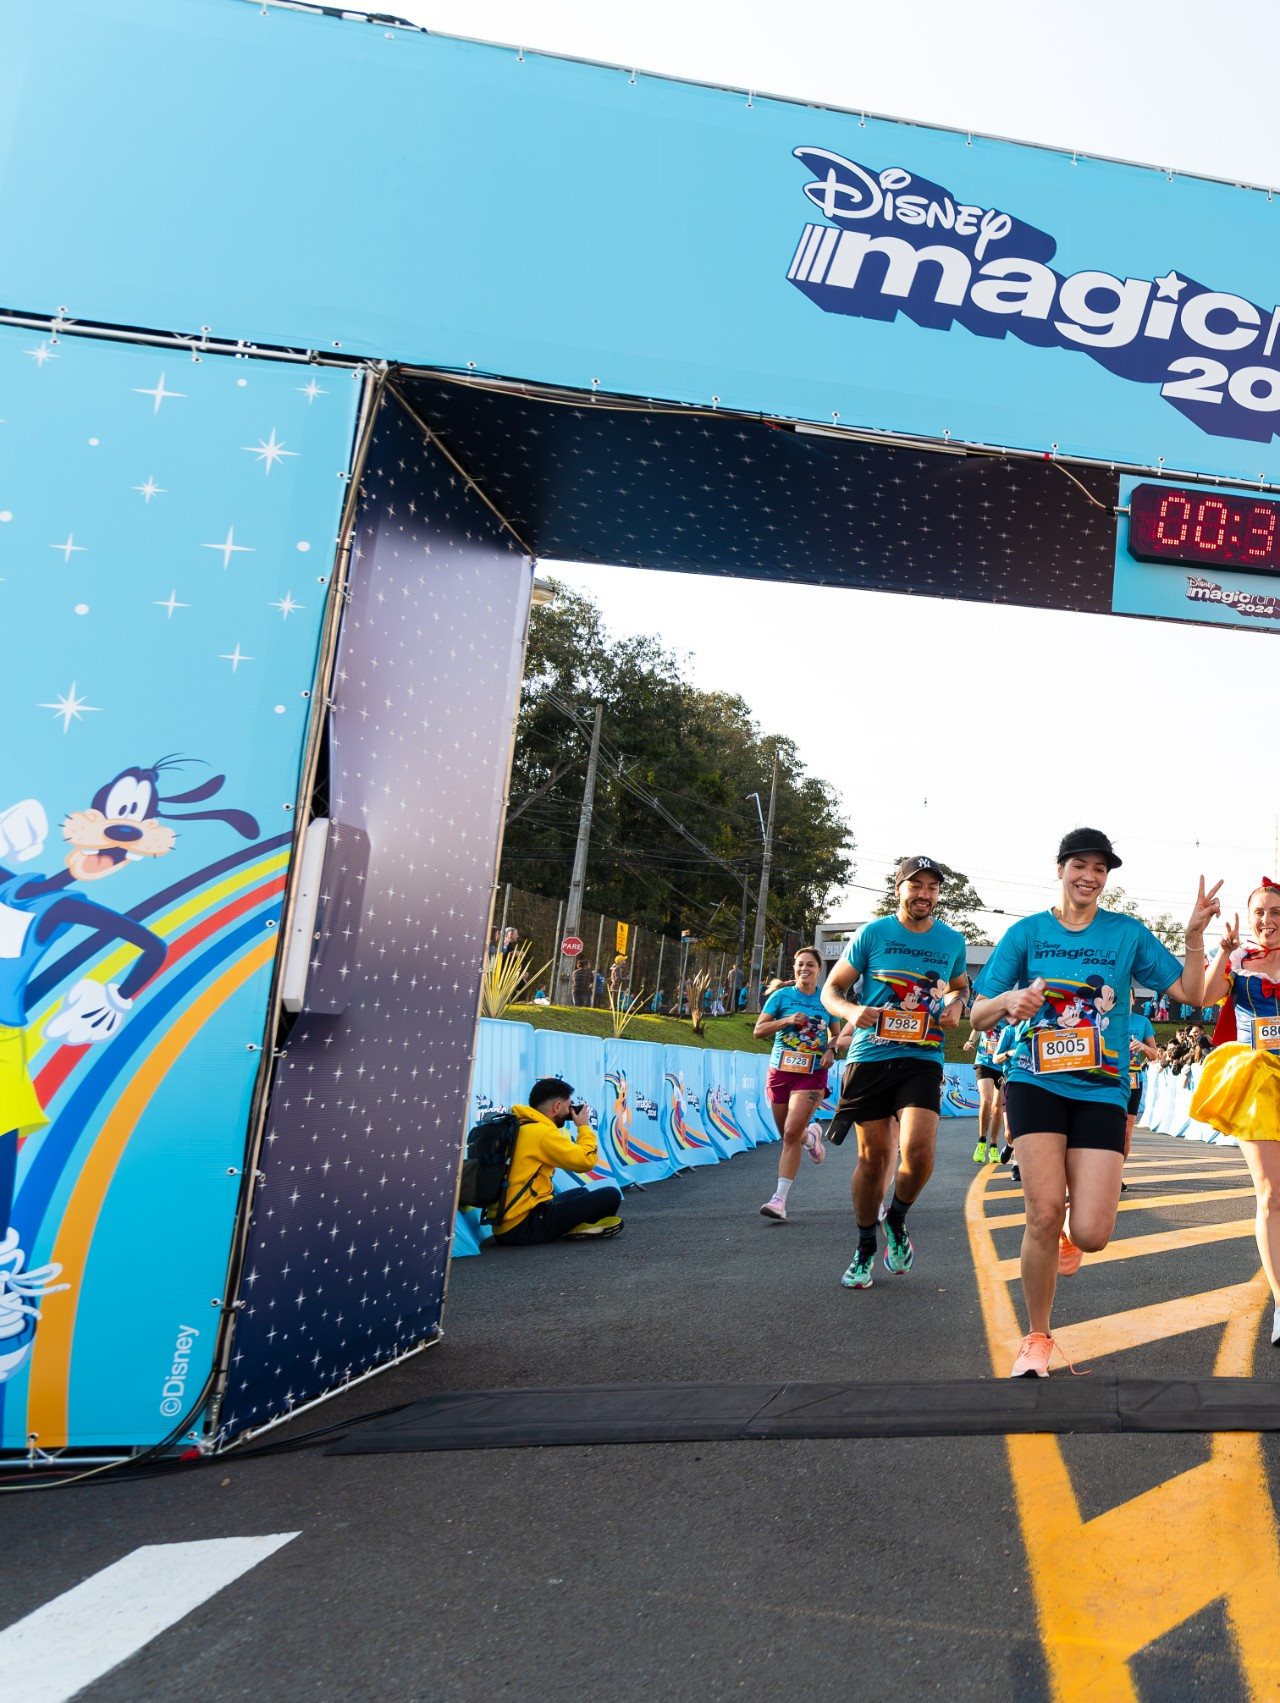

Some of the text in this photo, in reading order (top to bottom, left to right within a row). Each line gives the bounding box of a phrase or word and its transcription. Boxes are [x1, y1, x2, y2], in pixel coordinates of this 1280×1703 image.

[1236, 603, 1274, 614] 2024
[562, 942, 582, 950] PARE
[1081, 957, 1117, 967] 2024
[888, 1018, 918, 1030] 7982
[1046, 1039, 1085, 1055] 8005
[786, 1056, 807, 1066] 6728
